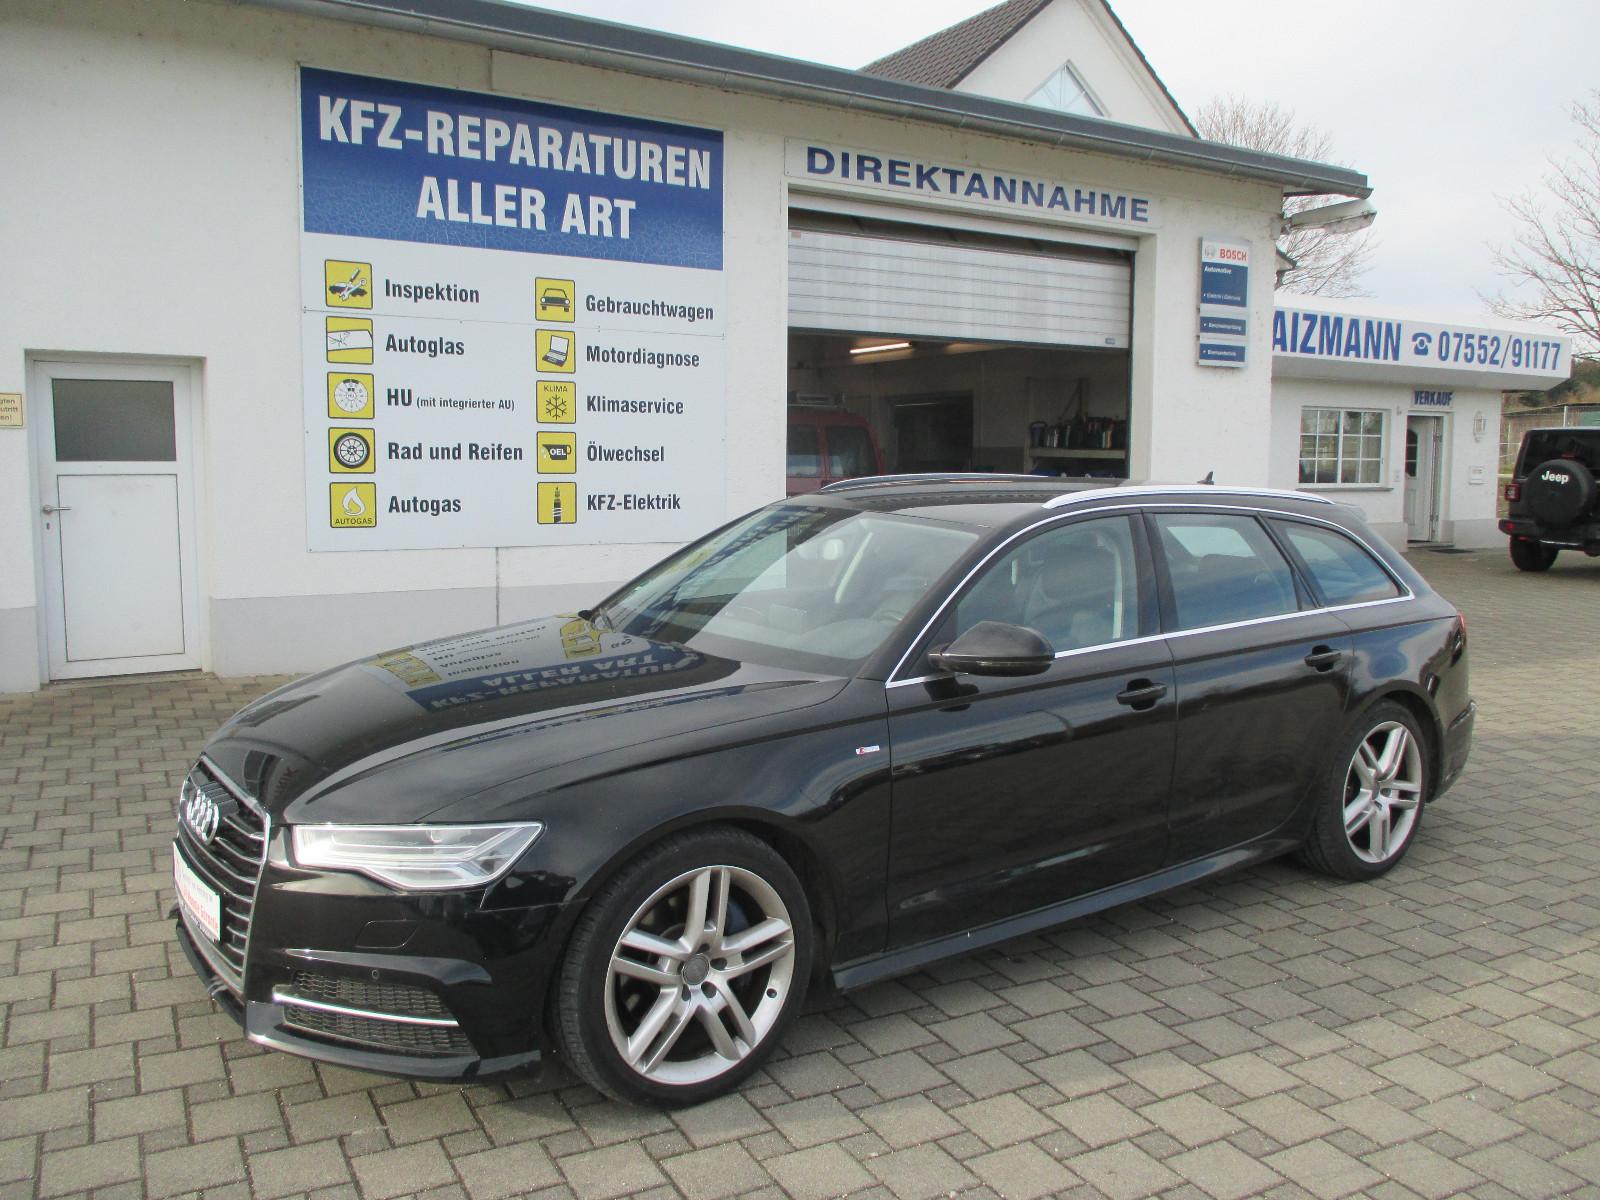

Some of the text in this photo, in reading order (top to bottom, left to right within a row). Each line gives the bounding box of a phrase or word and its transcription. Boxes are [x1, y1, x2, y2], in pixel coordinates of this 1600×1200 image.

[318, 94, 712, 191] KFZ-REPARATUREN
[806, 145, 1150, 224] DIREKTANNAHME
[415, 175, 637, 240] ALLER ART
[1219, 248, 1248, 262] BOSCH
[384, 278, 481, 304] Inspektion
[585, 294, 715, 322] Gebrauchtwagen
[385, 333, 466, 358] Autoglas
[1272, 309, 1402, 361] AIZMANN
[585, 345, 701, 369] Motordiagnose
[1437, 330, 1562, 371] 07552/91177
[387, 388, 516, 411] HU (mit integrierter AU)
[543, 384, 569, 393] KLIMA
[1414, 390, 1453, 406] VERKAUF
[586, 395, 685, 415] Klimaservice
[387, 442, 524, 462] Rad und Reifen
[549, 448, 567, 456] OEL
[586, 440, 665, 462] Ölwechsel
[1542, 471, 1569, 485] Jeep
[388, 494, 462, 515] Autogas
[586, 490, 682, 511] KFZ-Elektrik
[334, 517, 373, 525] AUTOGAS
